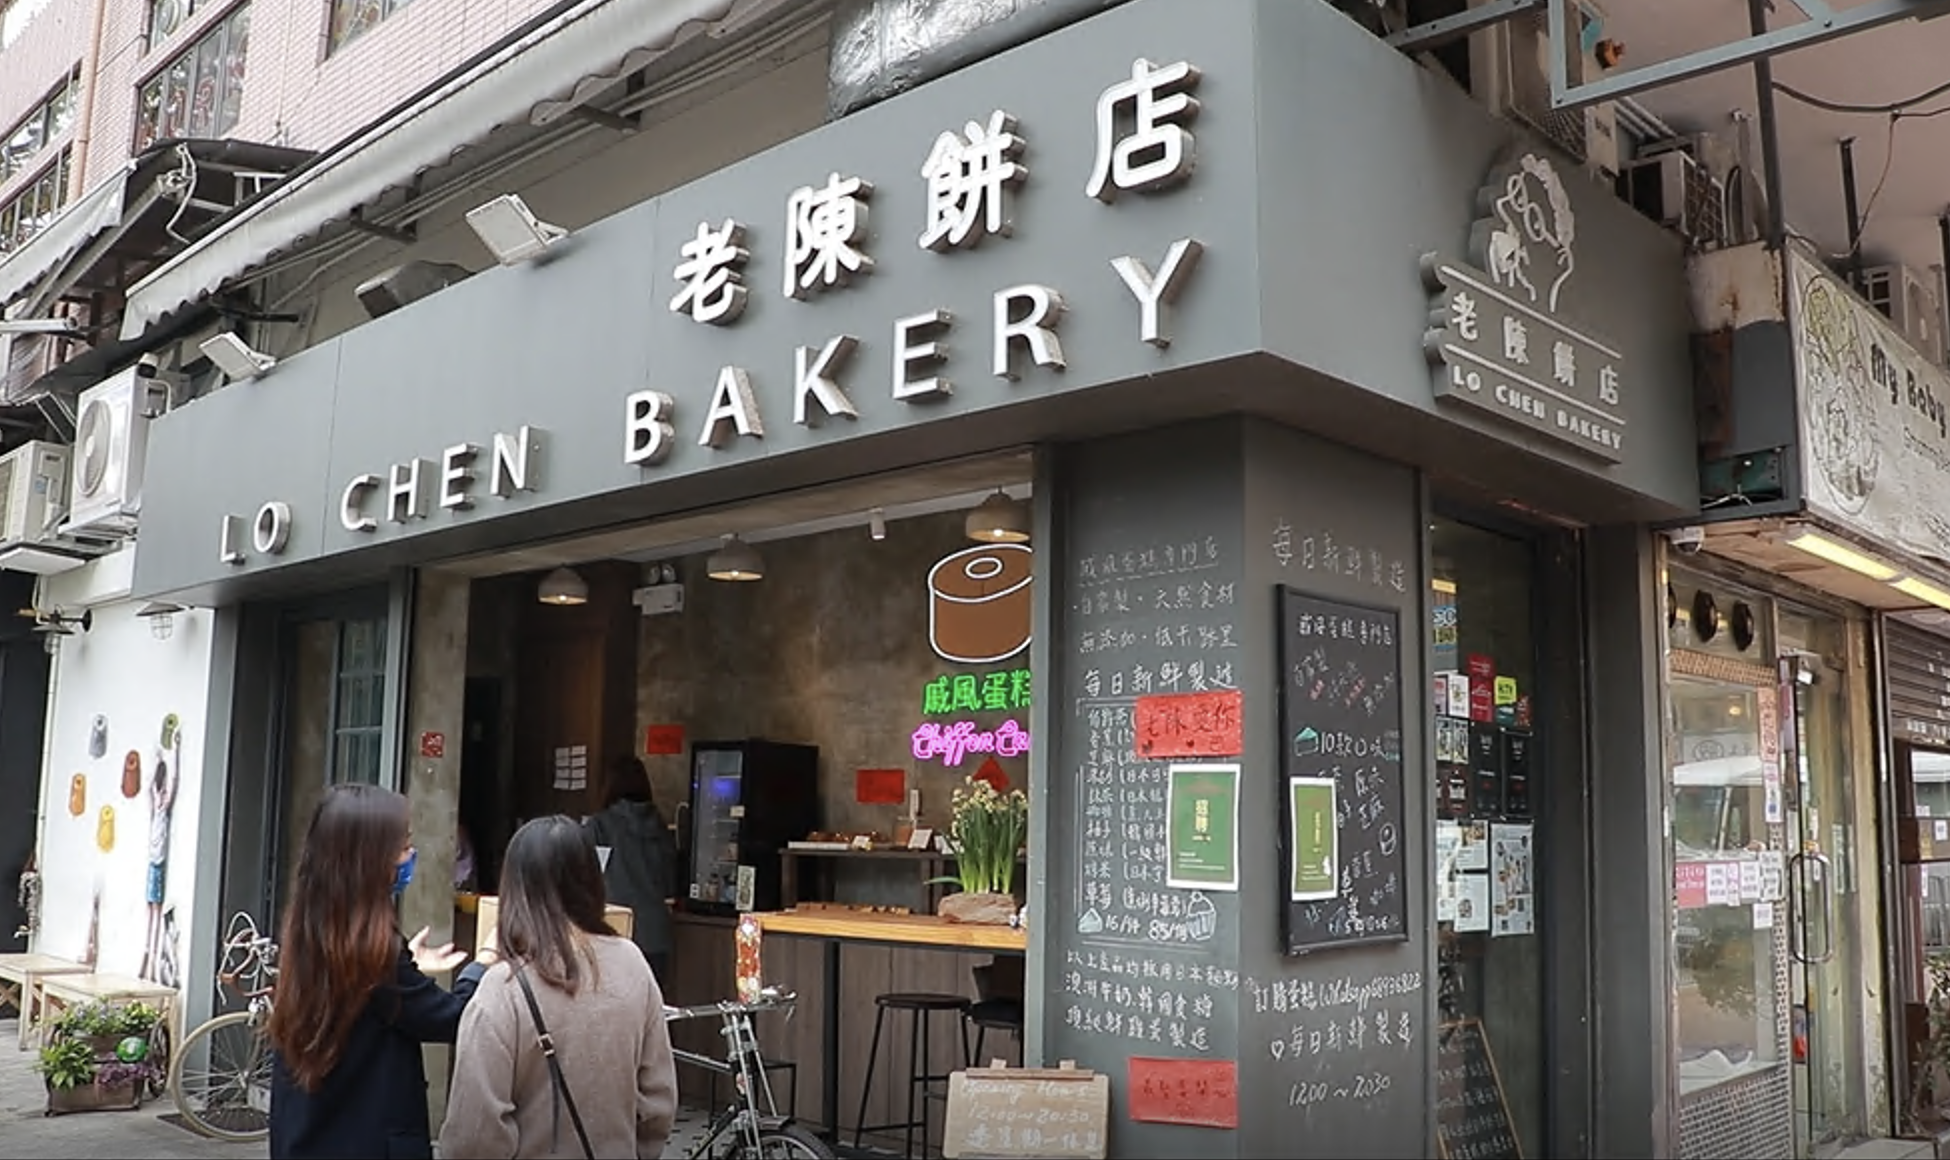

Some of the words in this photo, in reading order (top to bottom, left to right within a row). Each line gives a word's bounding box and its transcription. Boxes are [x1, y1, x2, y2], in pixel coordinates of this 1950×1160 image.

[669, 57, 1200, 324] 老陳餅店
[220, 500, 291, 565] LO
[340, 425, 548, 533] CHEN
[624, 239, 1207, 467] BAKERY
[1453, 365, 1481, 392] LO
[1495, 385, 1545, 419] CHEN
[1556, 409, 1622, 450] BAKERY
[1084, 661, 1239, 697] 每日新鮮製造
